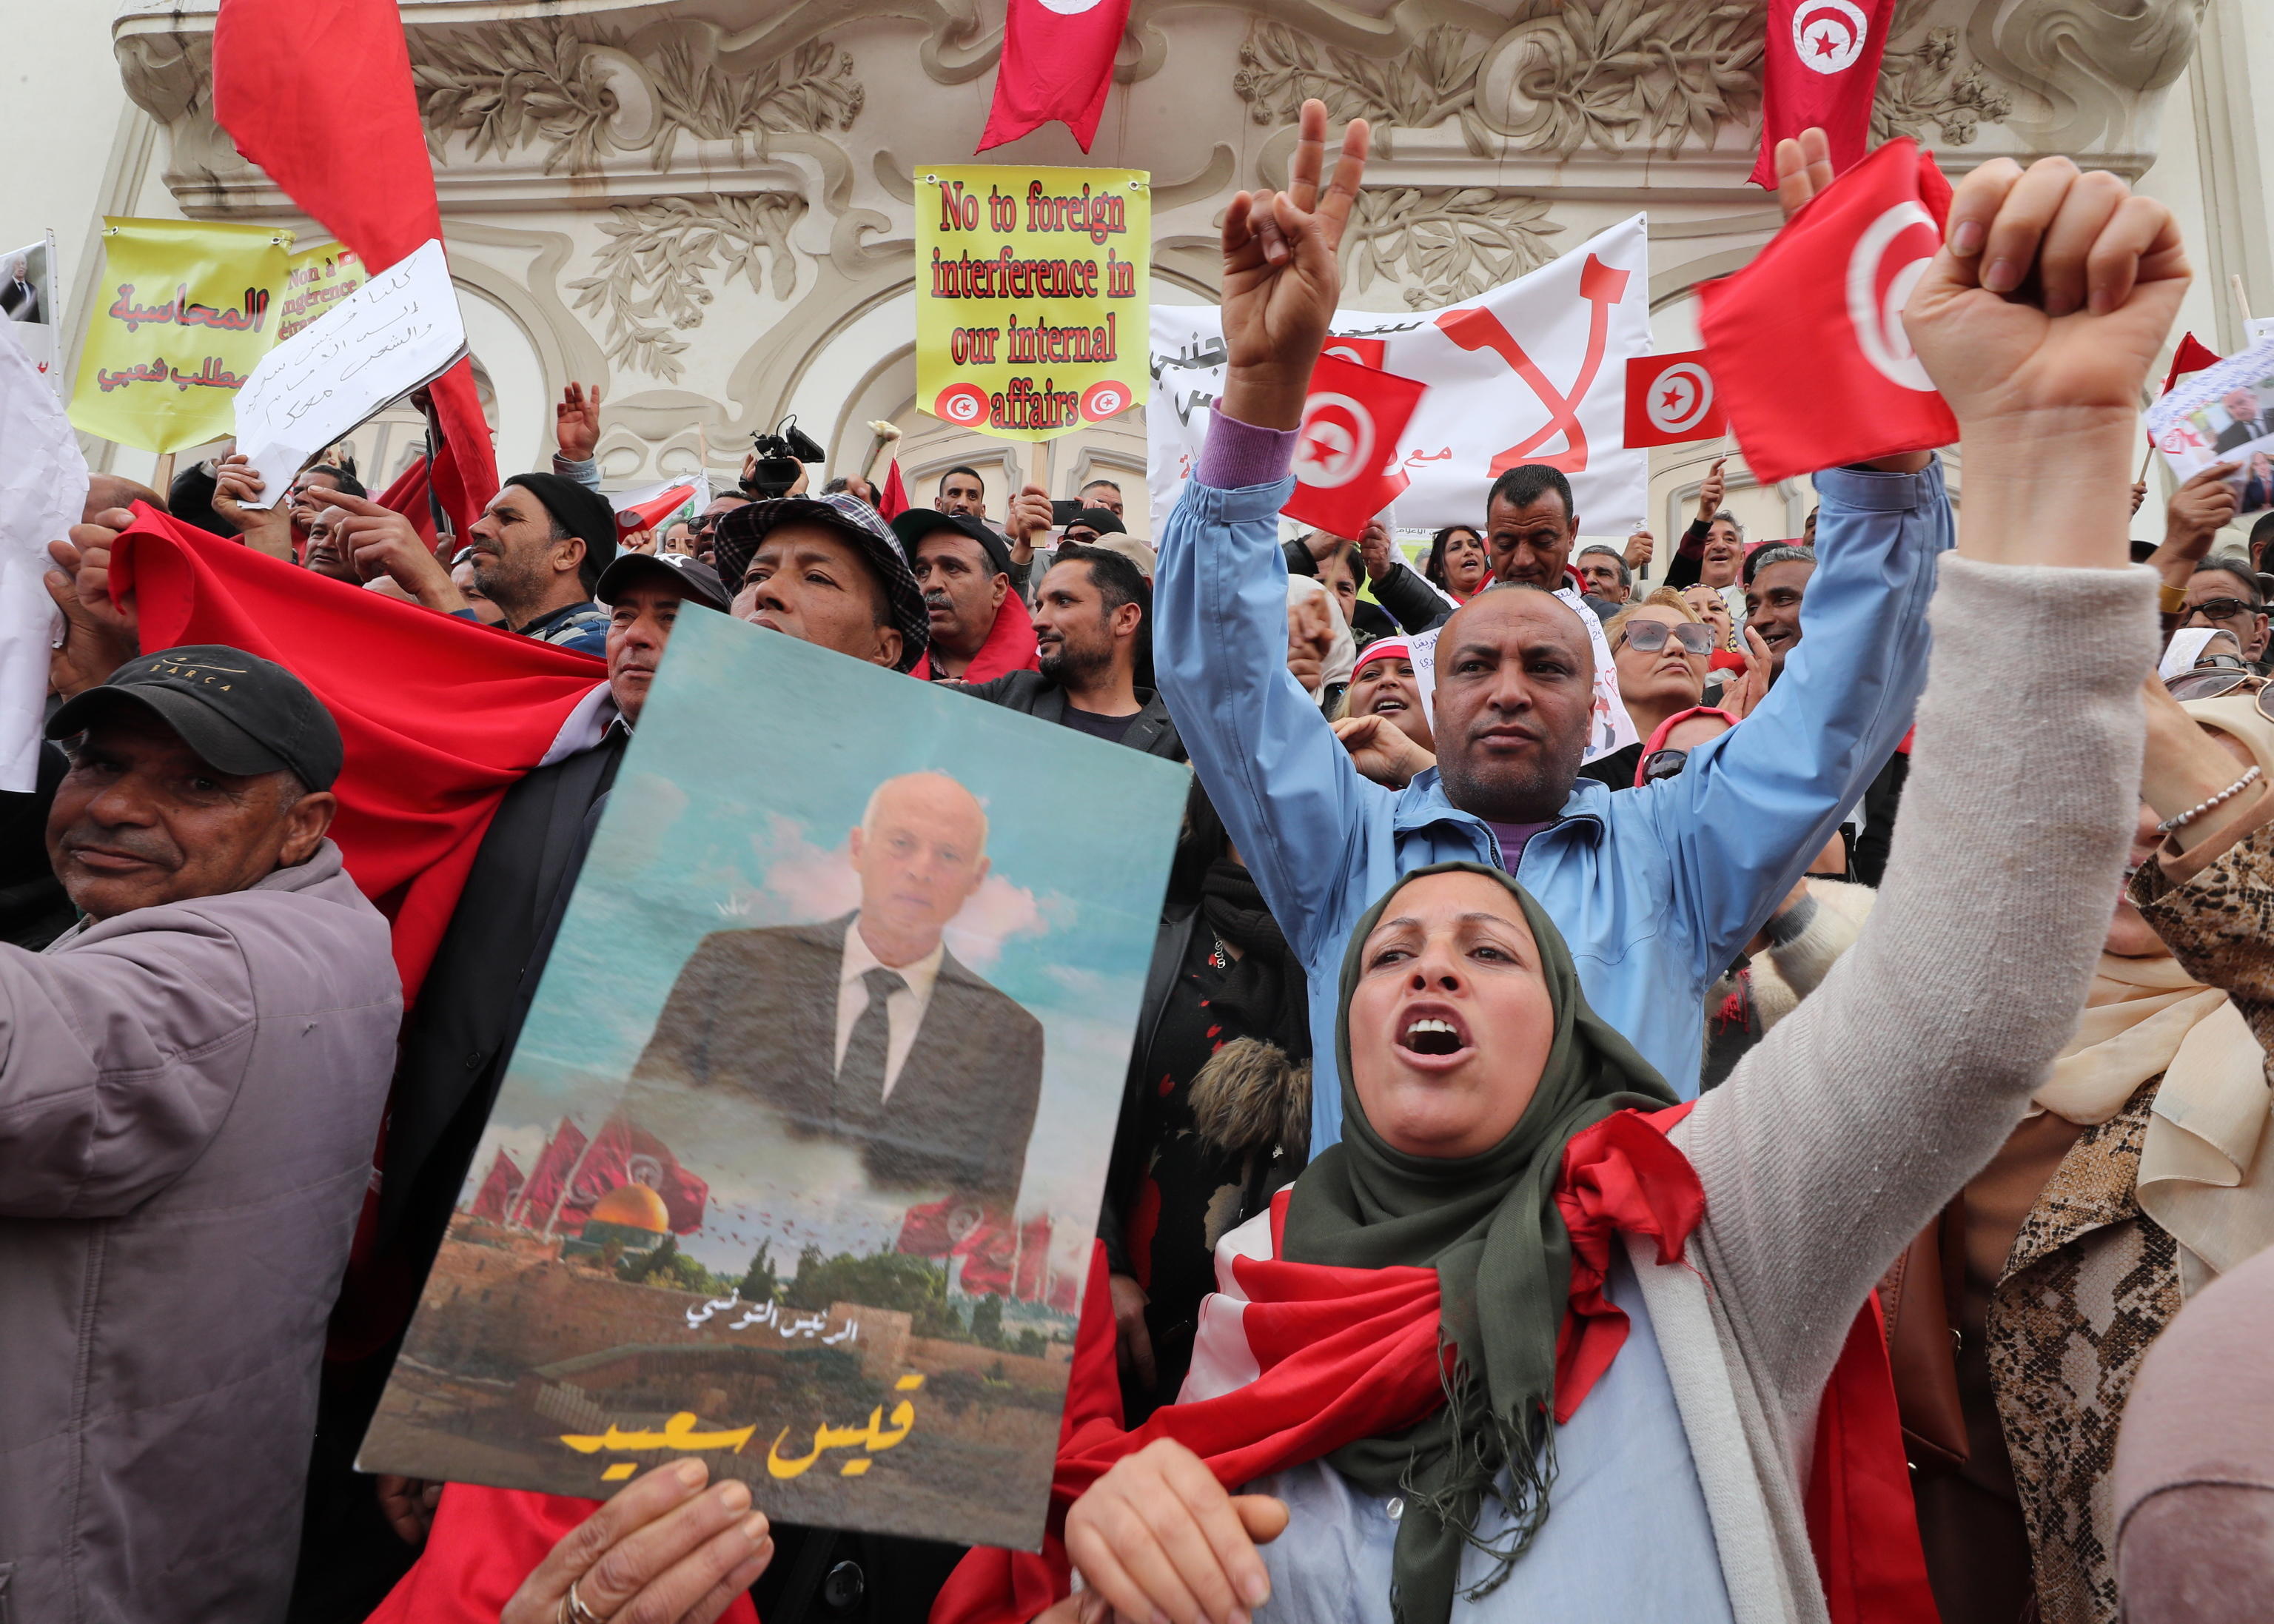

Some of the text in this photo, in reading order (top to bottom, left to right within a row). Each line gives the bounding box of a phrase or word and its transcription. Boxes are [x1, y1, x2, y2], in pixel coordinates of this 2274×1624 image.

[939, 180, 1126, 245] No to foreign
[287, 266, 321, 290] Non
[931, 246, 1136, 298] interference in
[109, 283, 269, 332] المحاسبة
[951, 312, 1117, 365] our internal
[98, 357, 168, 392] شعبي
[1433, 252, 1631, 478] لا
[990, 378, 1079, 430] affairs
[685, 1287, 858, 1345] الرئيس التونسي
[560, 1375, 925, 1480] قيس سعيد
